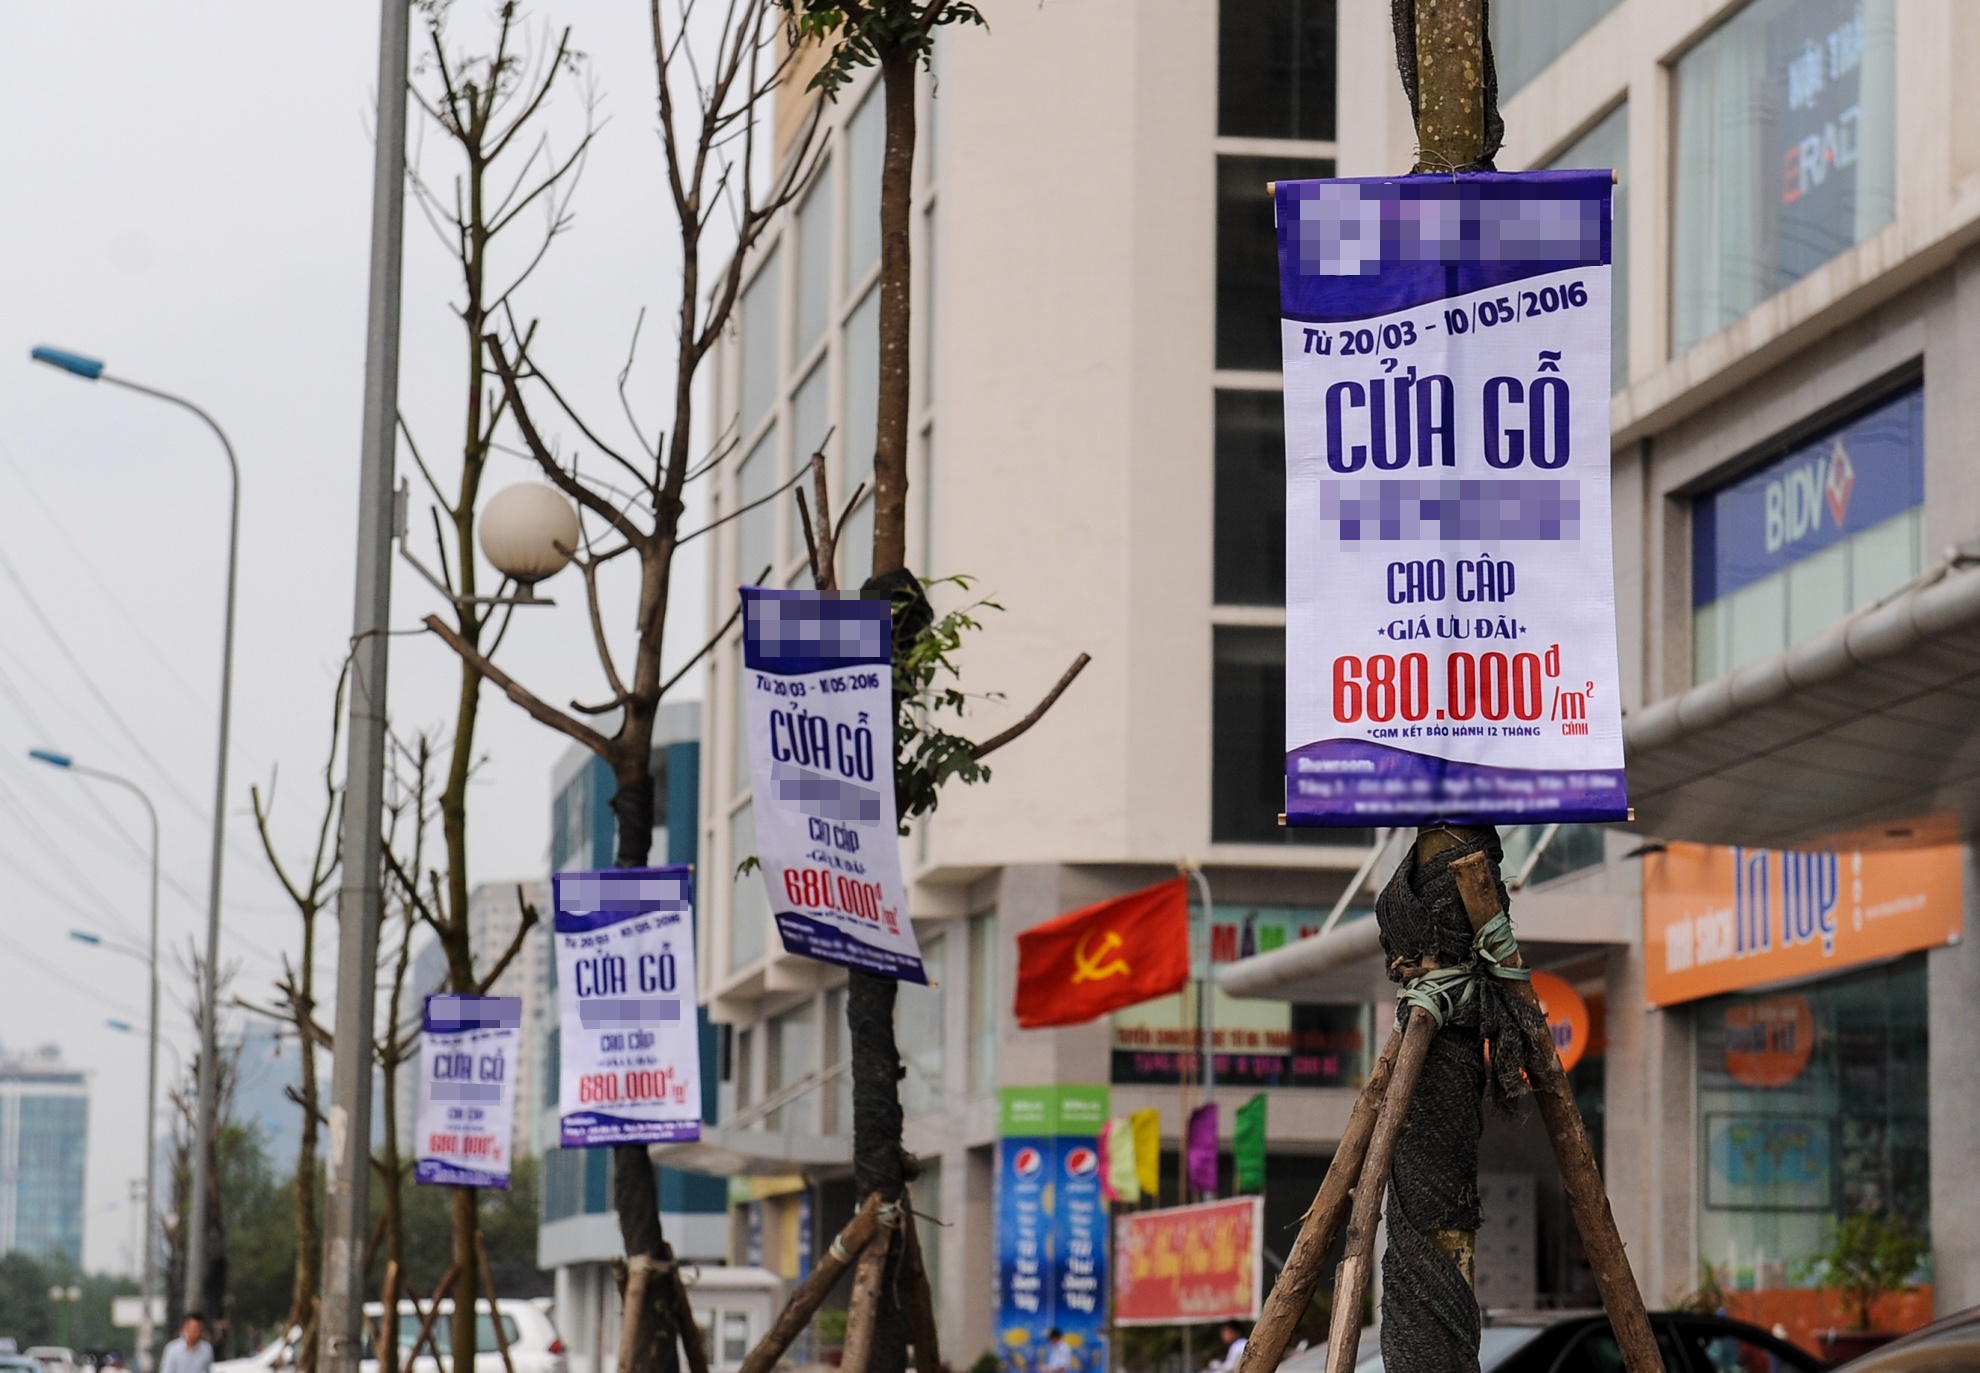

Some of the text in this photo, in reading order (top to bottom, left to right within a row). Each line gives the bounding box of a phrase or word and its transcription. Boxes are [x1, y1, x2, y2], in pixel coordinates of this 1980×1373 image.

[1303, 328, 1333, 356] Từ
[1340, 320, 1418, 356] 20/03
[1444, 281, 1588, 336] 10/05/2016
[1325, 351, 1570, 473] CỬA GỖ
[1765, 458, 1826, 553] BIDV
[1387, 559, 1446, 604] CAO
[1387, 614, 1517, 640] GIÁ ƯU ĐÃI
[770, 701, 874, 782] CỬA GỖ
[1402, 723, 1422, 738] KẾT
[1488, 727, 1498, 737] 12
